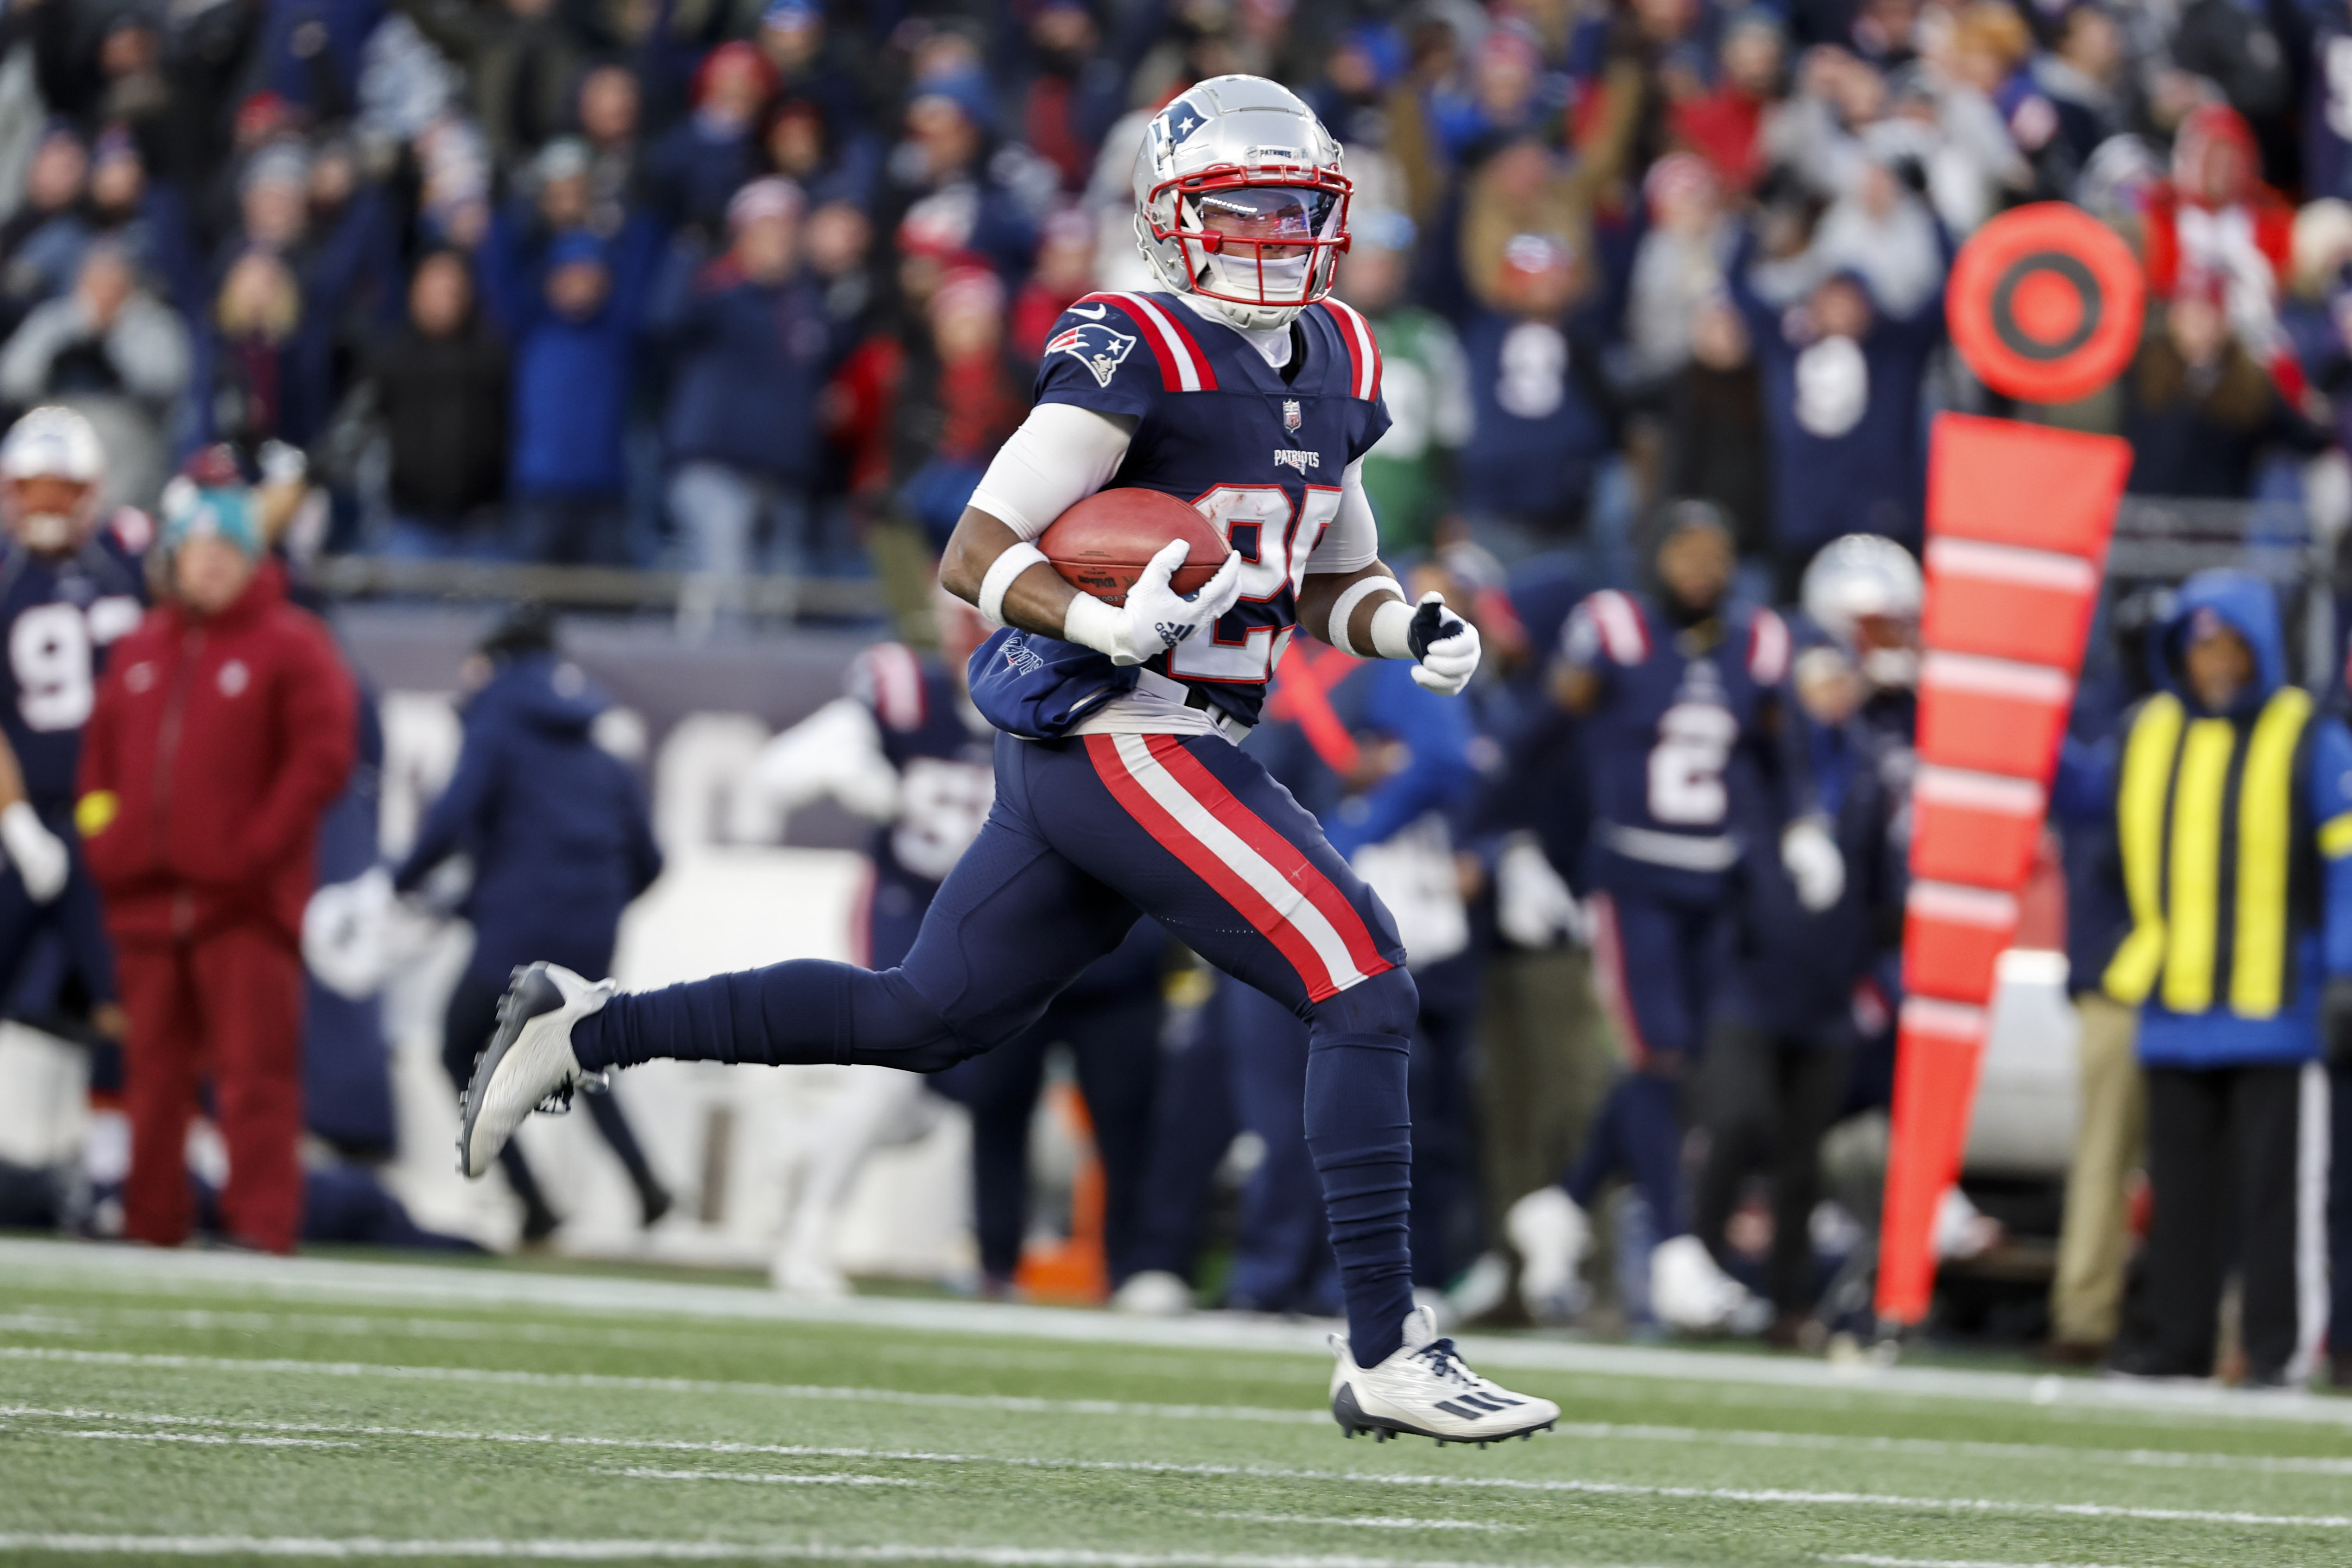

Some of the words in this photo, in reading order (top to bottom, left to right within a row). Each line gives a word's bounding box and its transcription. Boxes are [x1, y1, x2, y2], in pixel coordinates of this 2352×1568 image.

[1274, 449, 1320, 468] PATRIOTS
[891, 754, 996, 882] 5
[1646, 704, 1739, 827] 2
